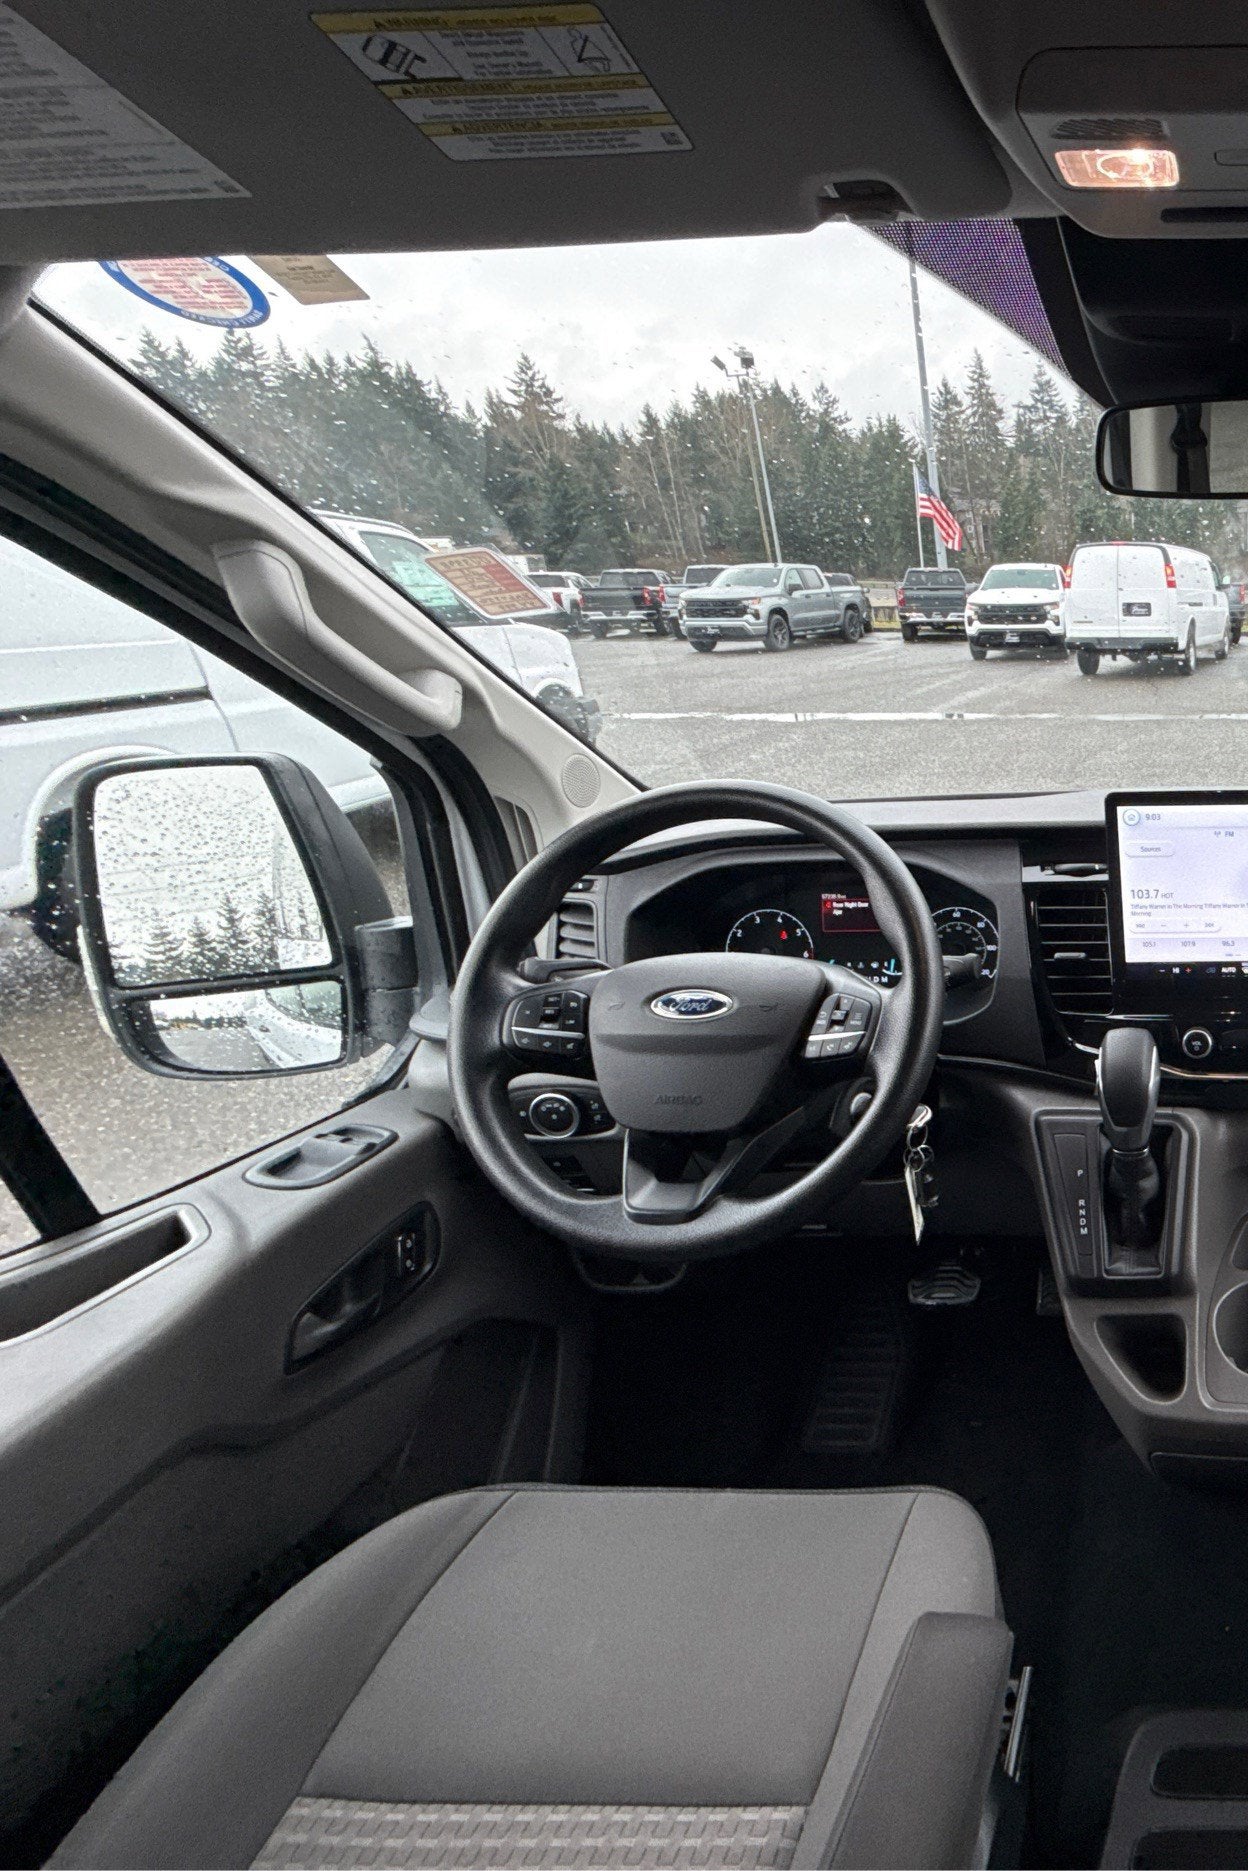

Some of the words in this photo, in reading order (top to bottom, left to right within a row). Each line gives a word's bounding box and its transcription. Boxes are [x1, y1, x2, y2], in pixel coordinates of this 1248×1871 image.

[1130, 889, 1159, 899] 103.7
[1221, 966, 1236, 974] AUTO
[669, 997, 712, 1012] Ford
[656, 1095, 702, 1105] AIRBAG
